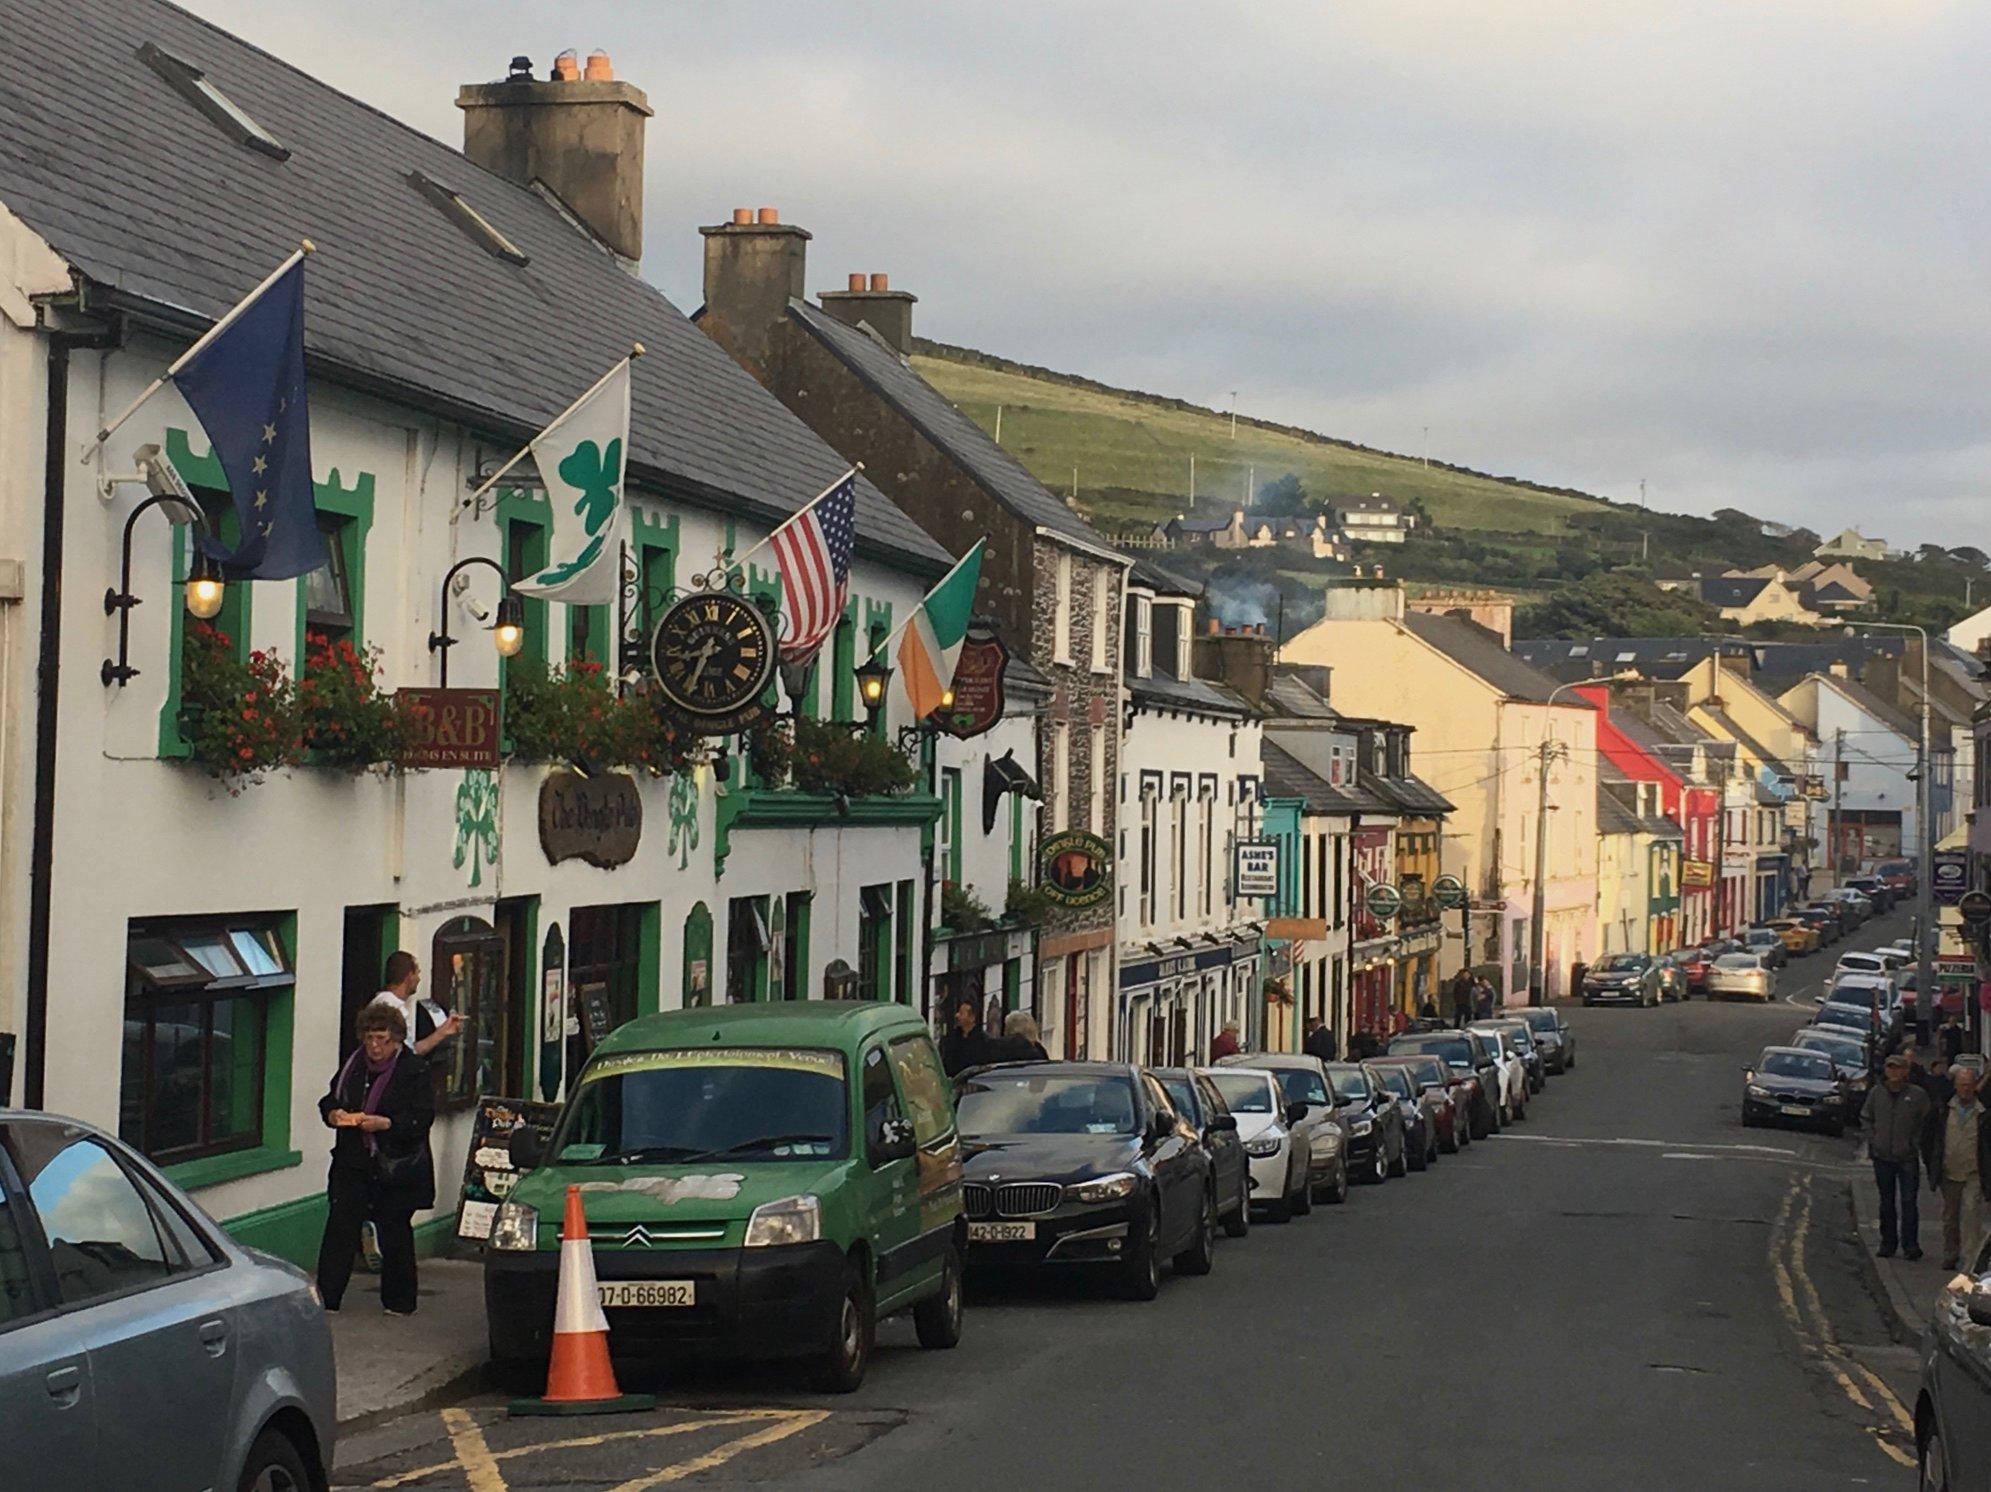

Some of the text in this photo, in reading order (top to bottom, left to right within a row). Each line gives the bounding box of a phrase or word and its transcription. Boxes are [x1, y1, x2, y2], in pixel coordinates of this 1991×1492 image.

[738, 706, 761, 724] PUB
[415, 704, 486, 746] B&B
[441, 751, 458, 761] EN
[460, 751, 492, 761] SUITE
[1045, 837, 1106, 858] DINGLE PUB
[1241, 850, 1275, 860] ASHE'S
[1247, 861, 1269, 872] BAR
[1044, 886, 1064, 901] OFF
